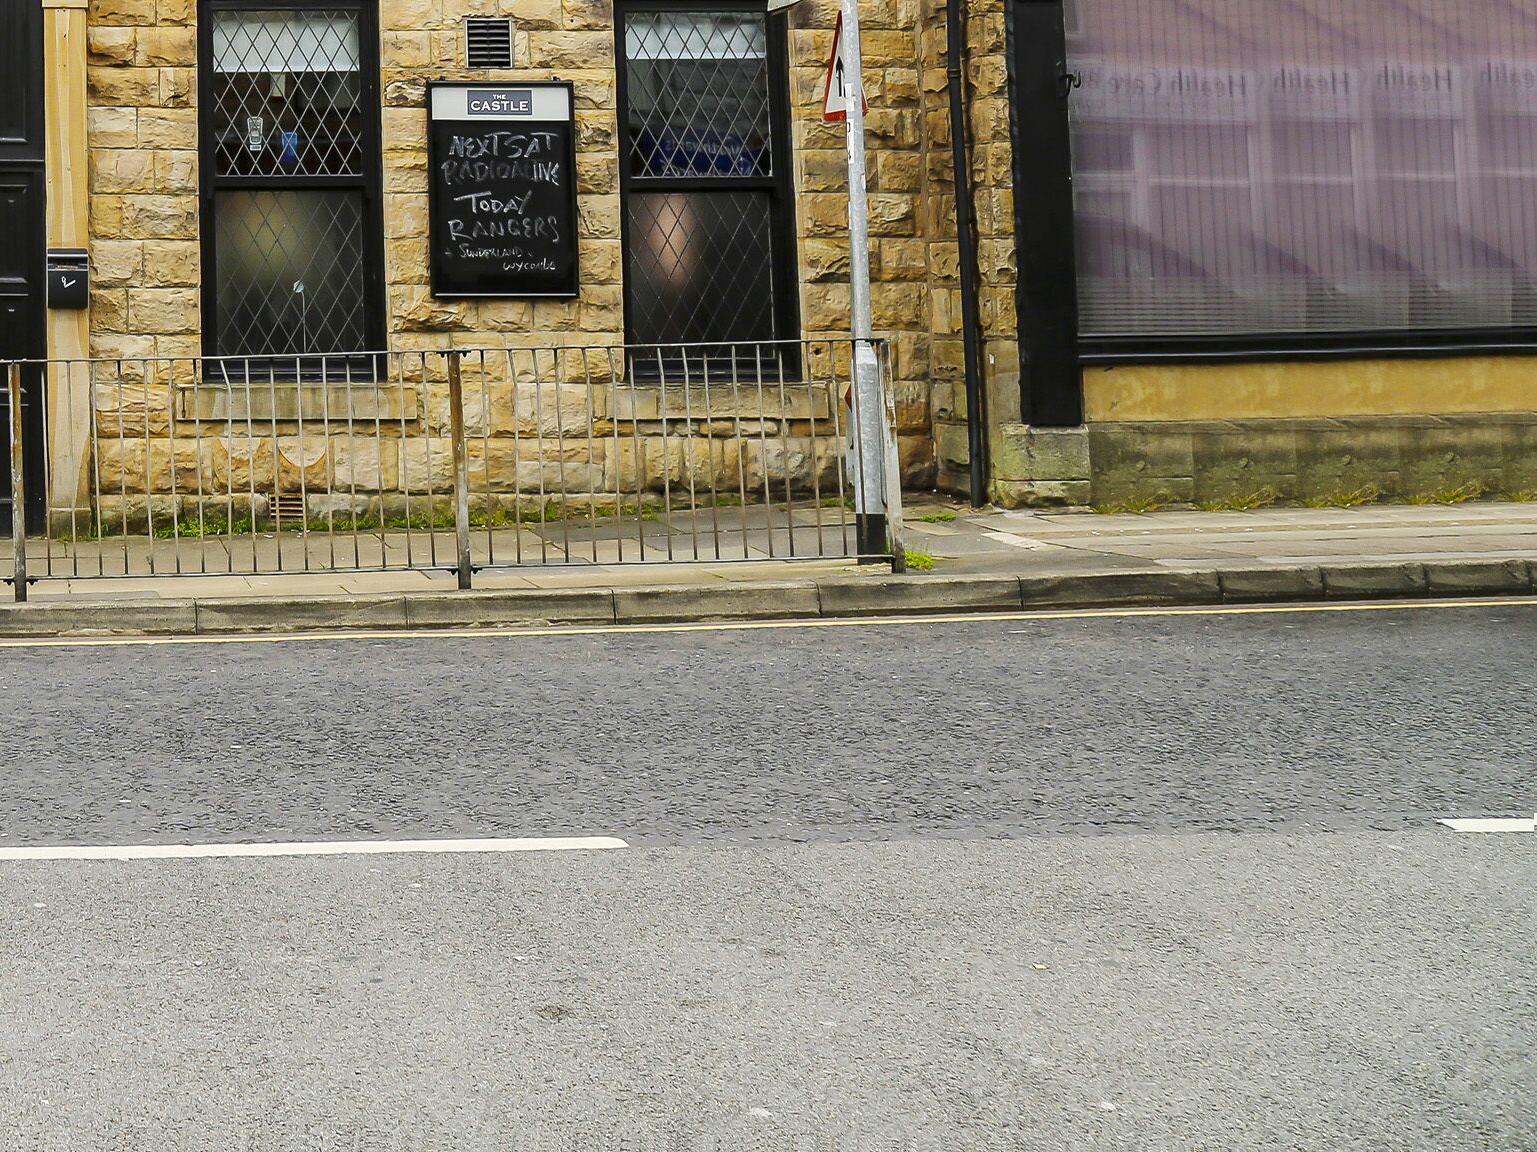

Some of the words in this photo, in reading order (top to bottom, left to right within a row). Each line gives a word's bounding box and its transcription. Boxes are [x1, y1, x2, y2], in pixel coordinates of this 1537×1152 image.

[470, 100, 529, 112] CASTLE
[449, 132, 511, 158] NEXT
[503, 132, 559, 158] SAT
[453, 190, 533, 215] TODAY
[448, 215, 559, 243] RANGERS
